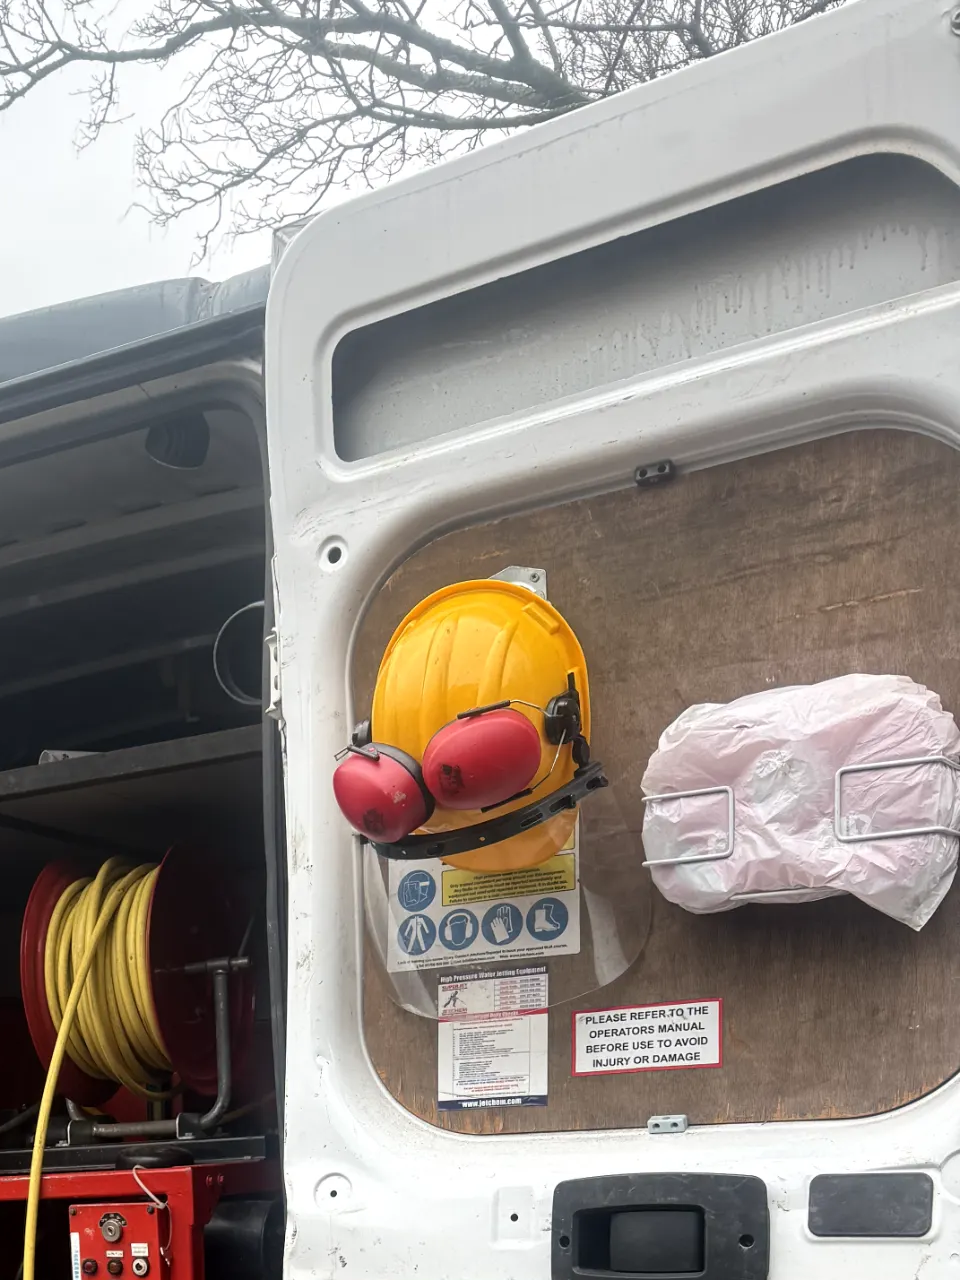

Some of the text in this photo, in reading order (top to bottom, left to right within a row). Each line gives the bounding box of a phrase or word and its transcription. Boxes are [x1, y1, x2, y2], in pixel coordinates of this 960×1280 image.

[440, 975, 453, 983] High
[454, 973, 478, 982] Pressure
[479, 971, 496, 979] Water
[517, 966, 547, 975] Equipment
[585, 1006, 709, 1025] PLEASE REFER TO THE
[589, 1022, 705, 1039] OPERATORS MANUAL
[586, 1036, 708, 1054] BEFORE USE TO AVOID
[592, 1052, 701, 1068] INJURY OR DAMAGE
[461, 1098, 522, 1108] www.jetchem.com
